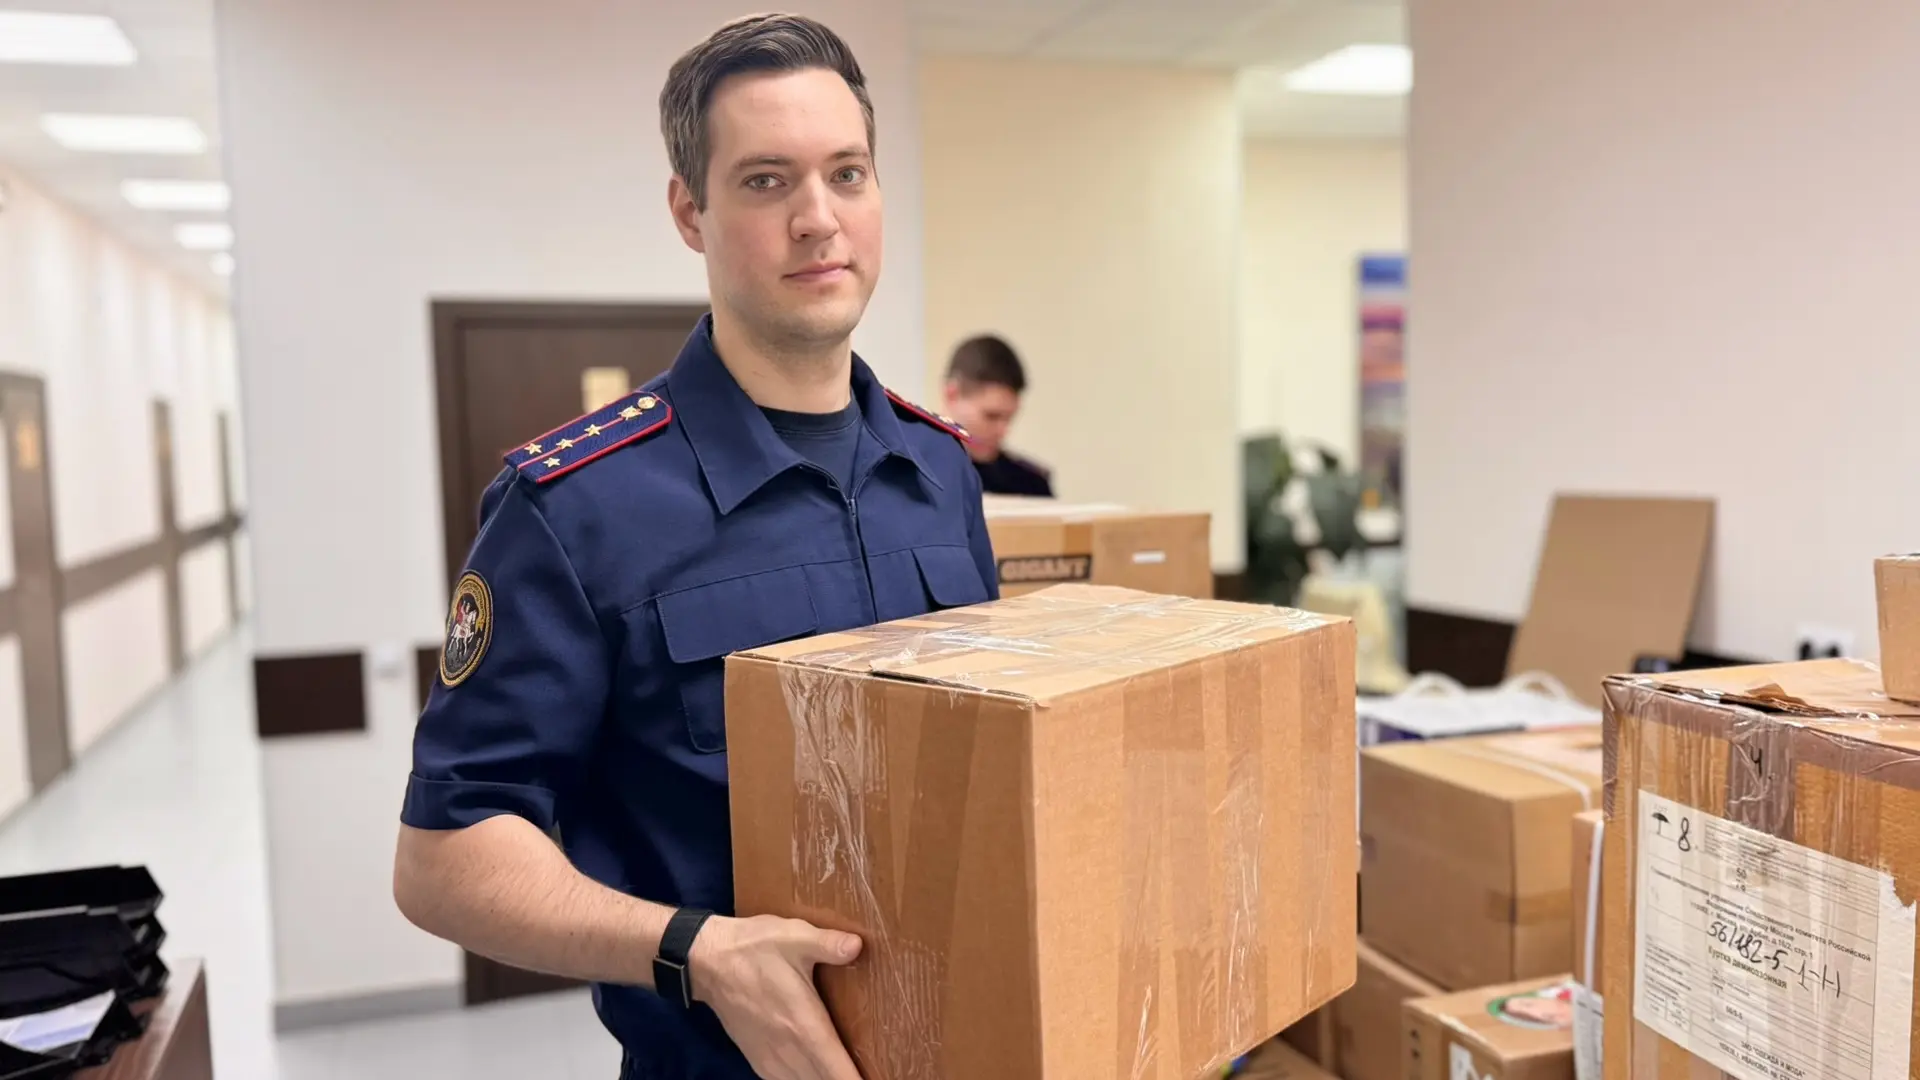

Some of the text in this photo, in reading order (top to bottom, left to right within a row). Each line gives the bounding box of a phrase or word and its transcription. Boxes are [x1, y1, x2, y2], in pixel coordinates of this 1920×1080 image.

[1000, 558, 1088, 580] GIGANT
[1795, 928, 1827, 945] комитета
[1828, 939, 1872, 962] Российской
